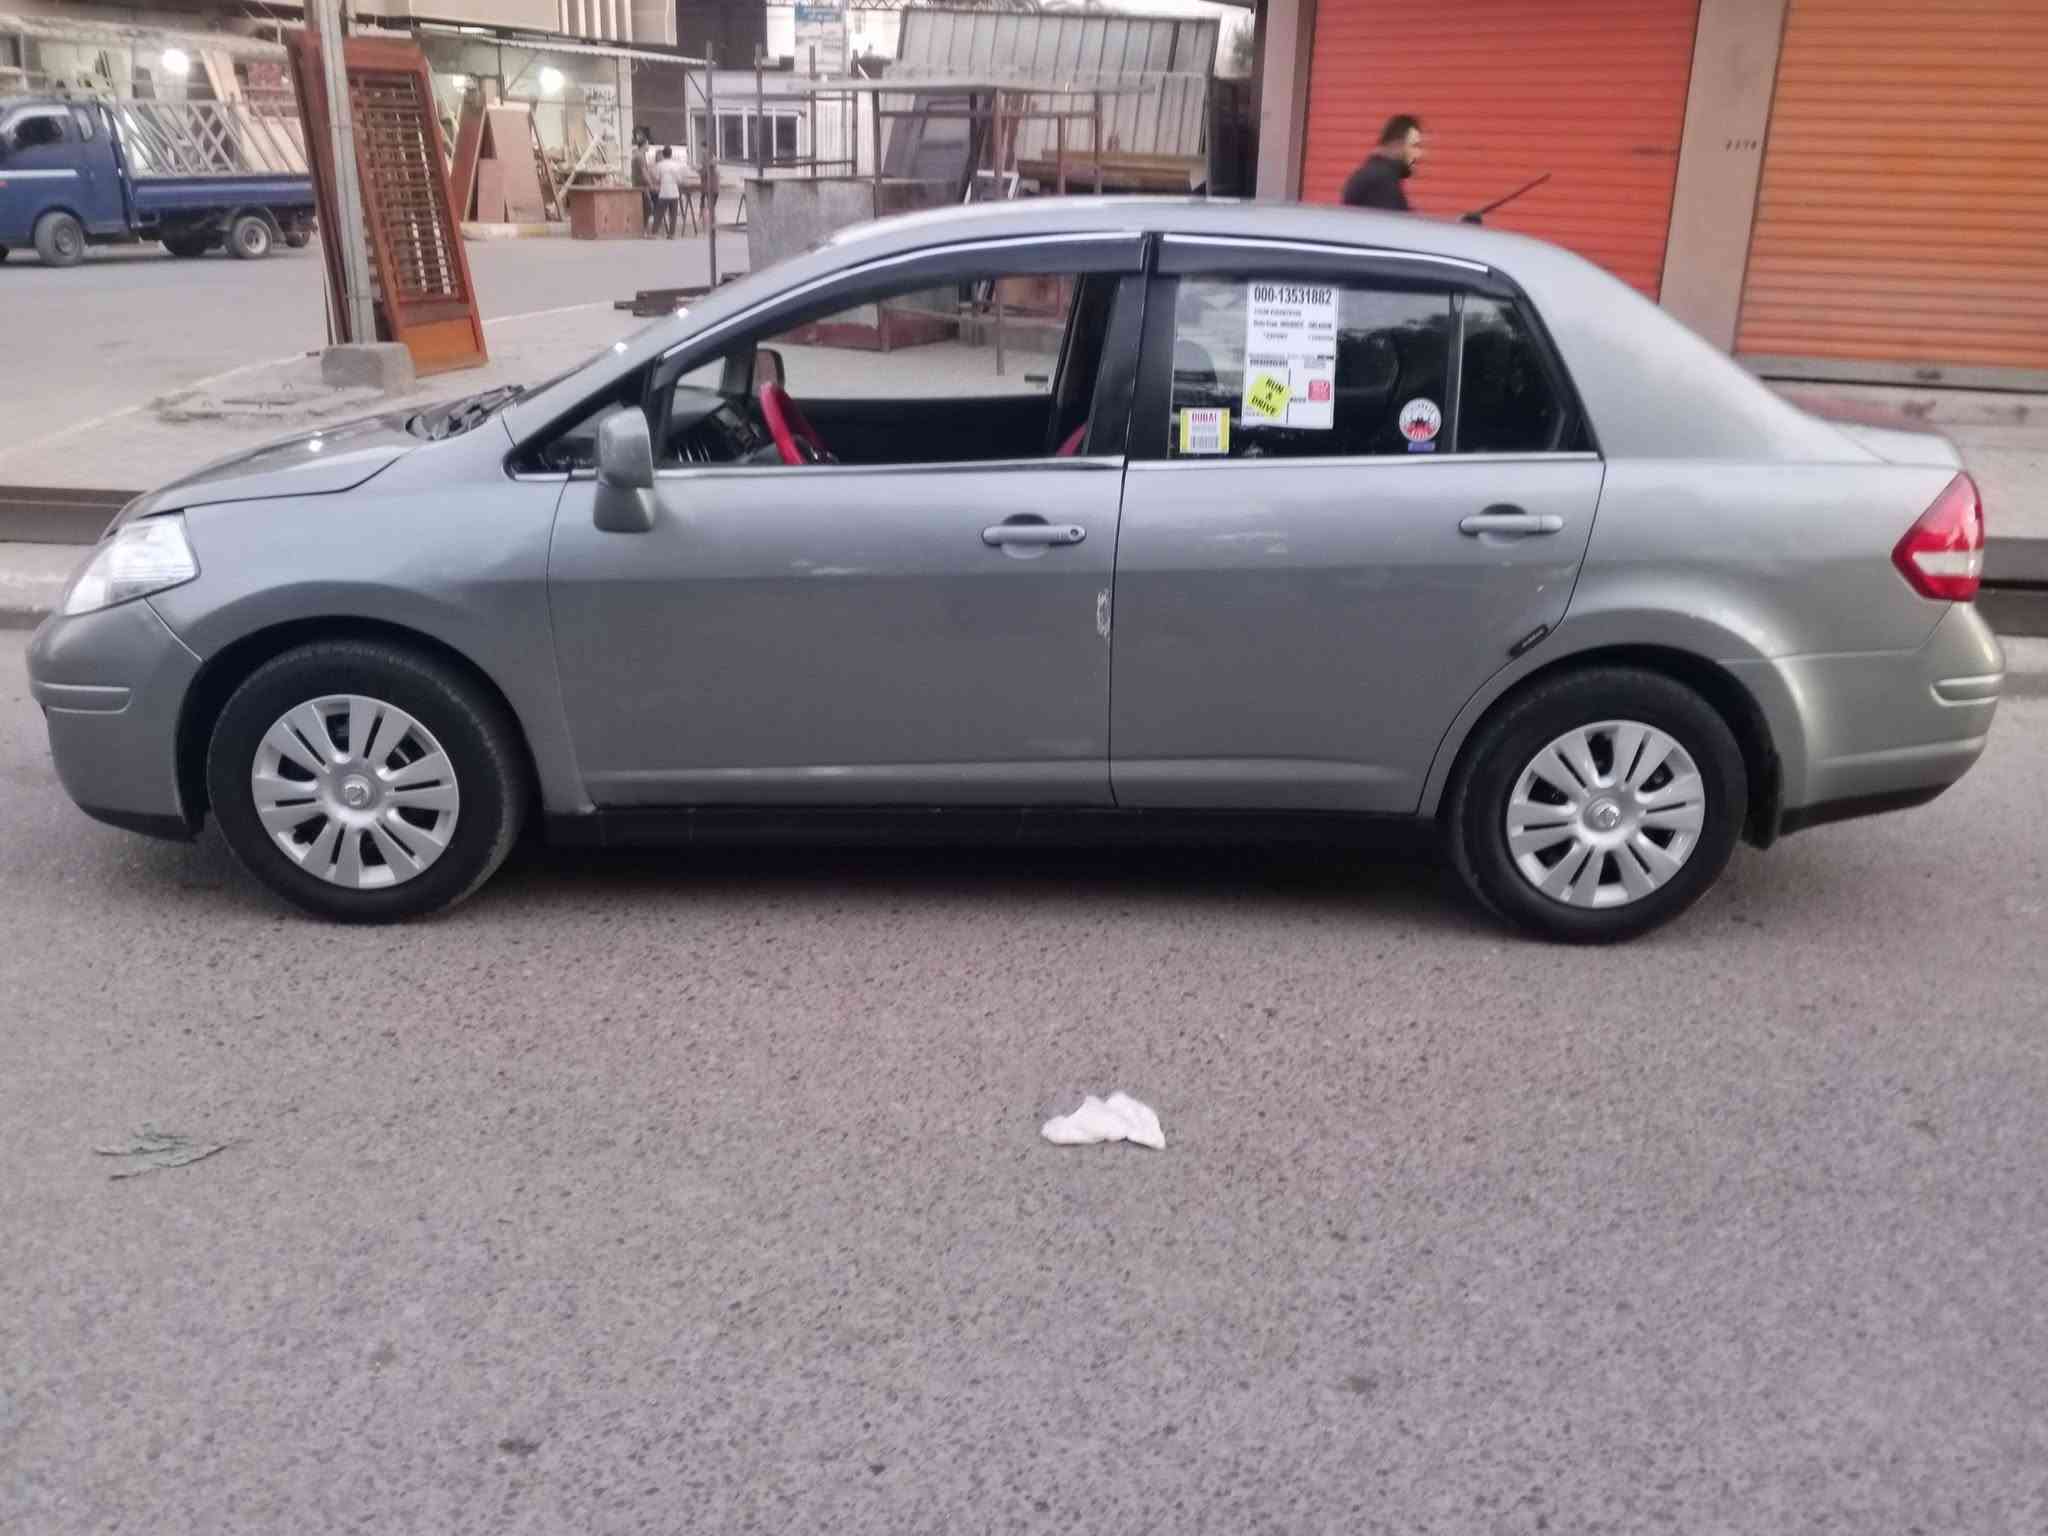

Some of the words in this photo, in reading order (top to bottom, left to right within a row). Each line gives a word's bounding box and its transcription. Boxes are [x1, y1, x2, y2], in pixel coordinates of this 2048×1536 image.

[1254, 286, 1332, 305] 000-13531882
[1265, 378, 1285, 393] RUN
[1251, 395, 1276, 414] DRIVE
